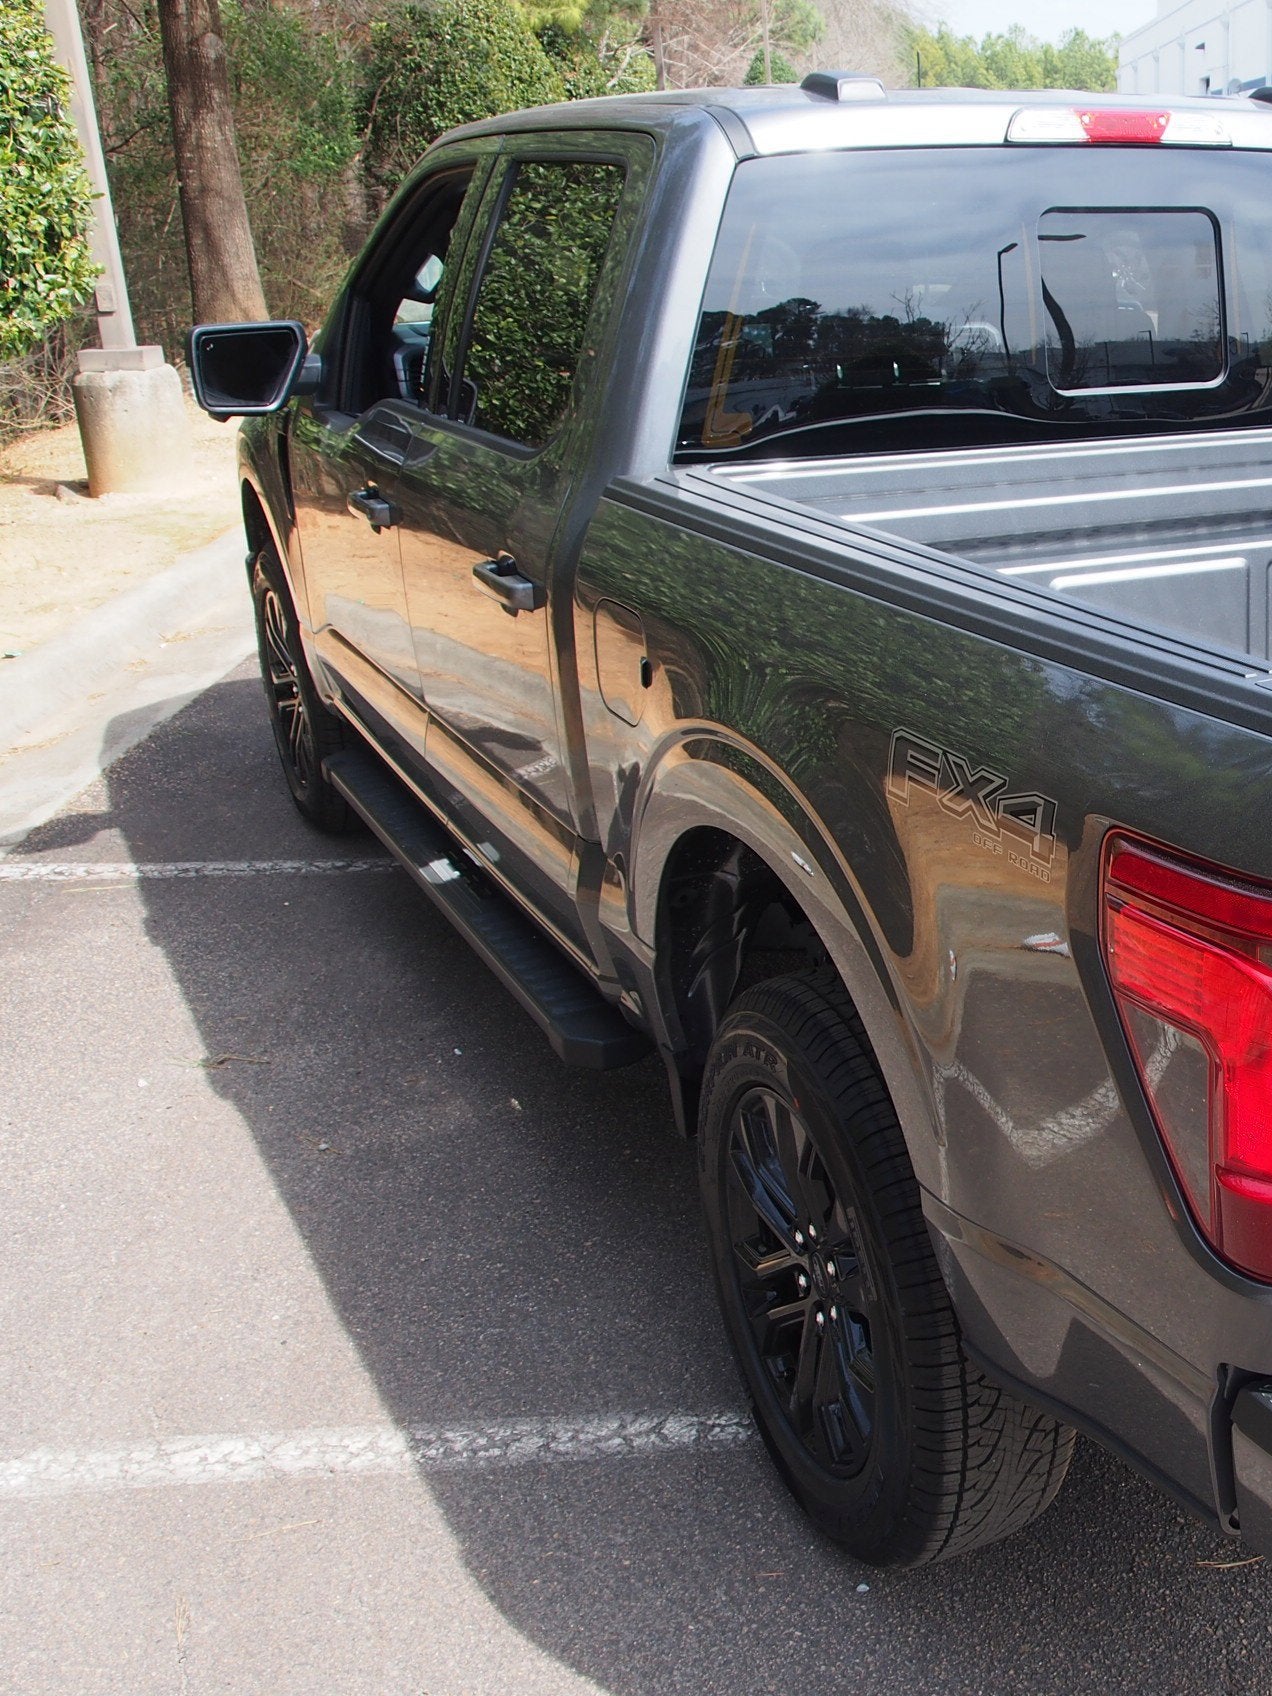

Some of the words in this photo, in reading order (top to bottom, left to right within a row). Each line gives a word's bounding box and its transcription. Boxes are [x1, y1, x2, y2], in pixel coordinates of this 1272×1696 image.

[973, 832, 1003, 855] OFF
[1007, 850, 1051, 884] ROAD
[743, 1042, 778, 1074] ATR
